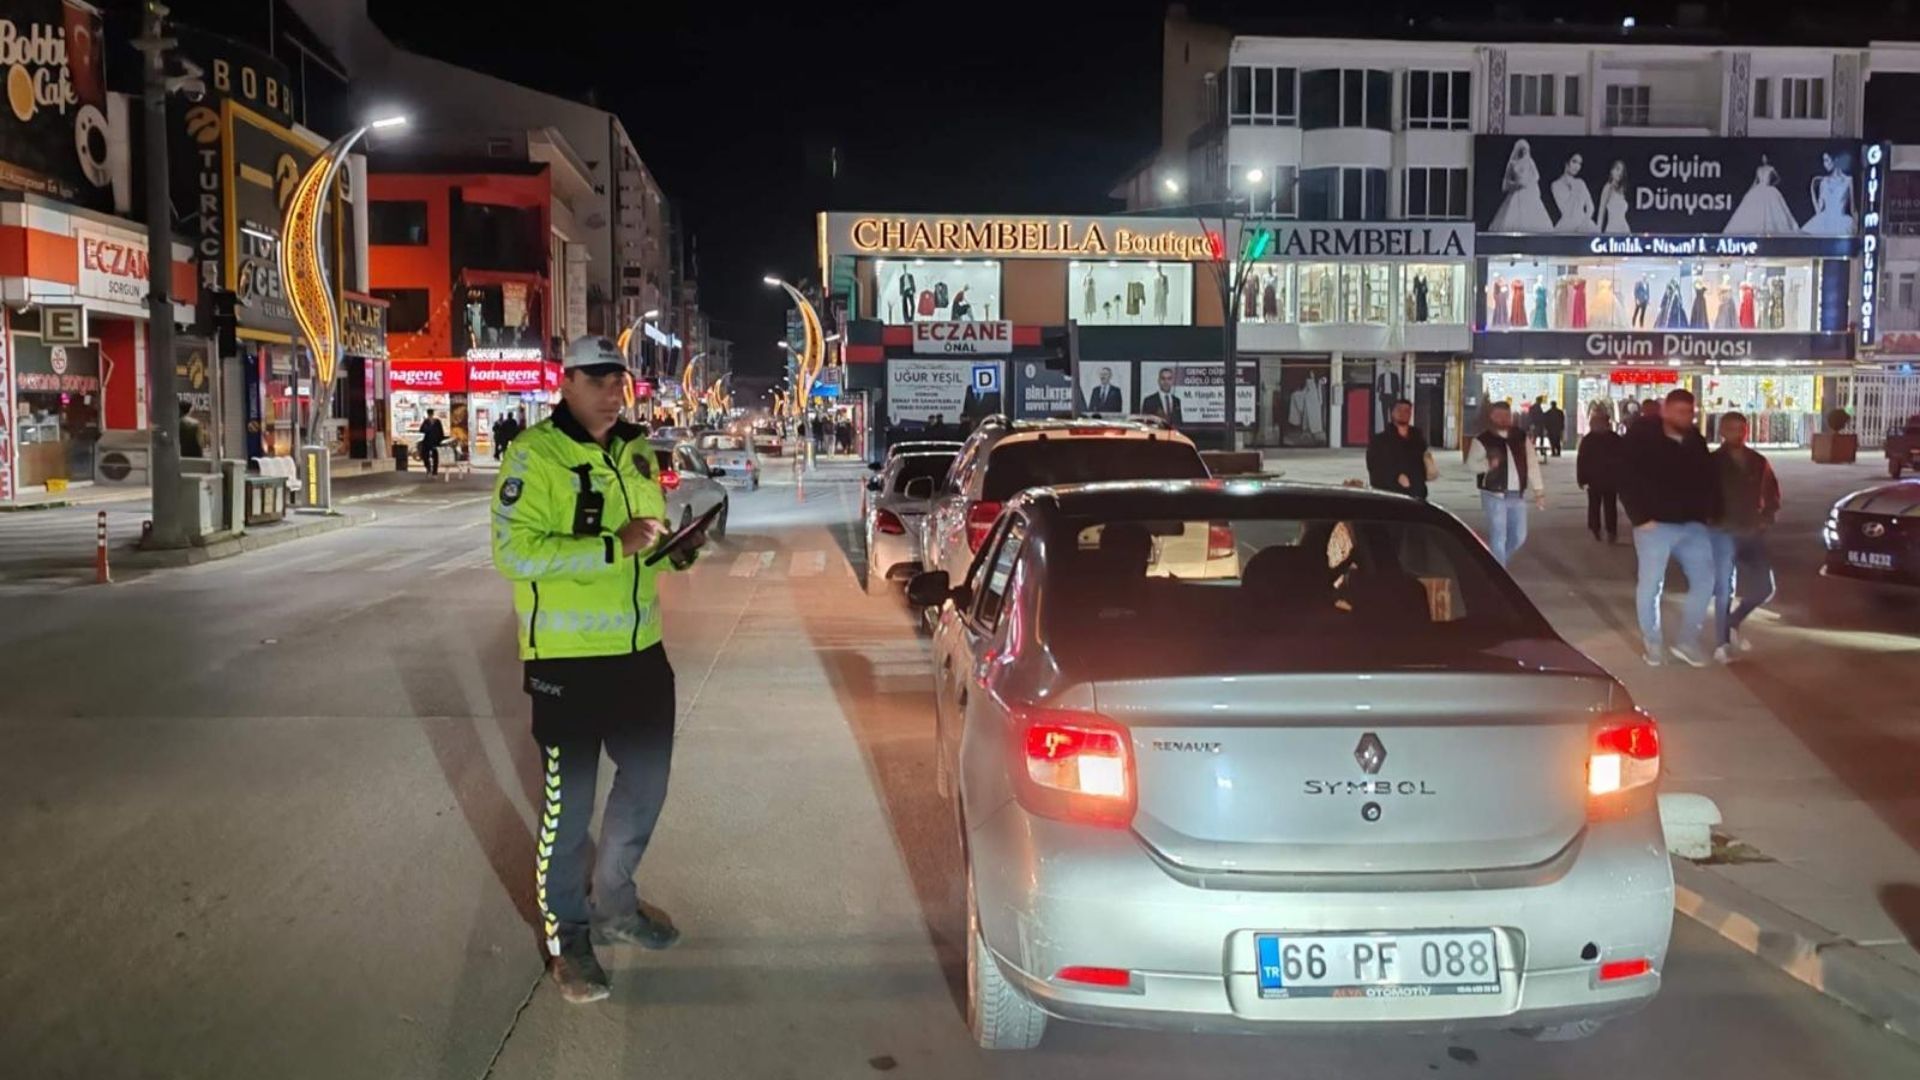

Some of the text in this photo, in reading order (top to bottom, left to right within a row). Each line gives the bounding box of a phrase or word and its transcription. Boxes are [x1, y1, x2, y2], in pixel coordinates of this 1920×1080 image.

[1649, 154, 1721, 183] Giyim
[1636, 187, 1732, 214] Dünyası
[852, 220, 1106, 253] CHARMBELLA
[1244, 227, 1467, 257] HARMBELLA
[108, 280, 141, 298] SORGUN
[53, 312, 74, 337] E
[917, 322, 1008, 341] ECZANE
[944, 343, 977, 352] ÖNAL
[1586, 334, 1752, 359] Giyim Dünyası
[470, 366, 541, 384] komagene
[894, 368, 962, 385] UĞUR YEŞİL
[979, 371, 992, 387] D
[1153, 741, 1222, 752] RENAULT
[1304, 780, 1436, 795] SYMBOL
[1283, 941, 1489, 980] 66 PF 088
[1264, 966, 1279, 978] TR
